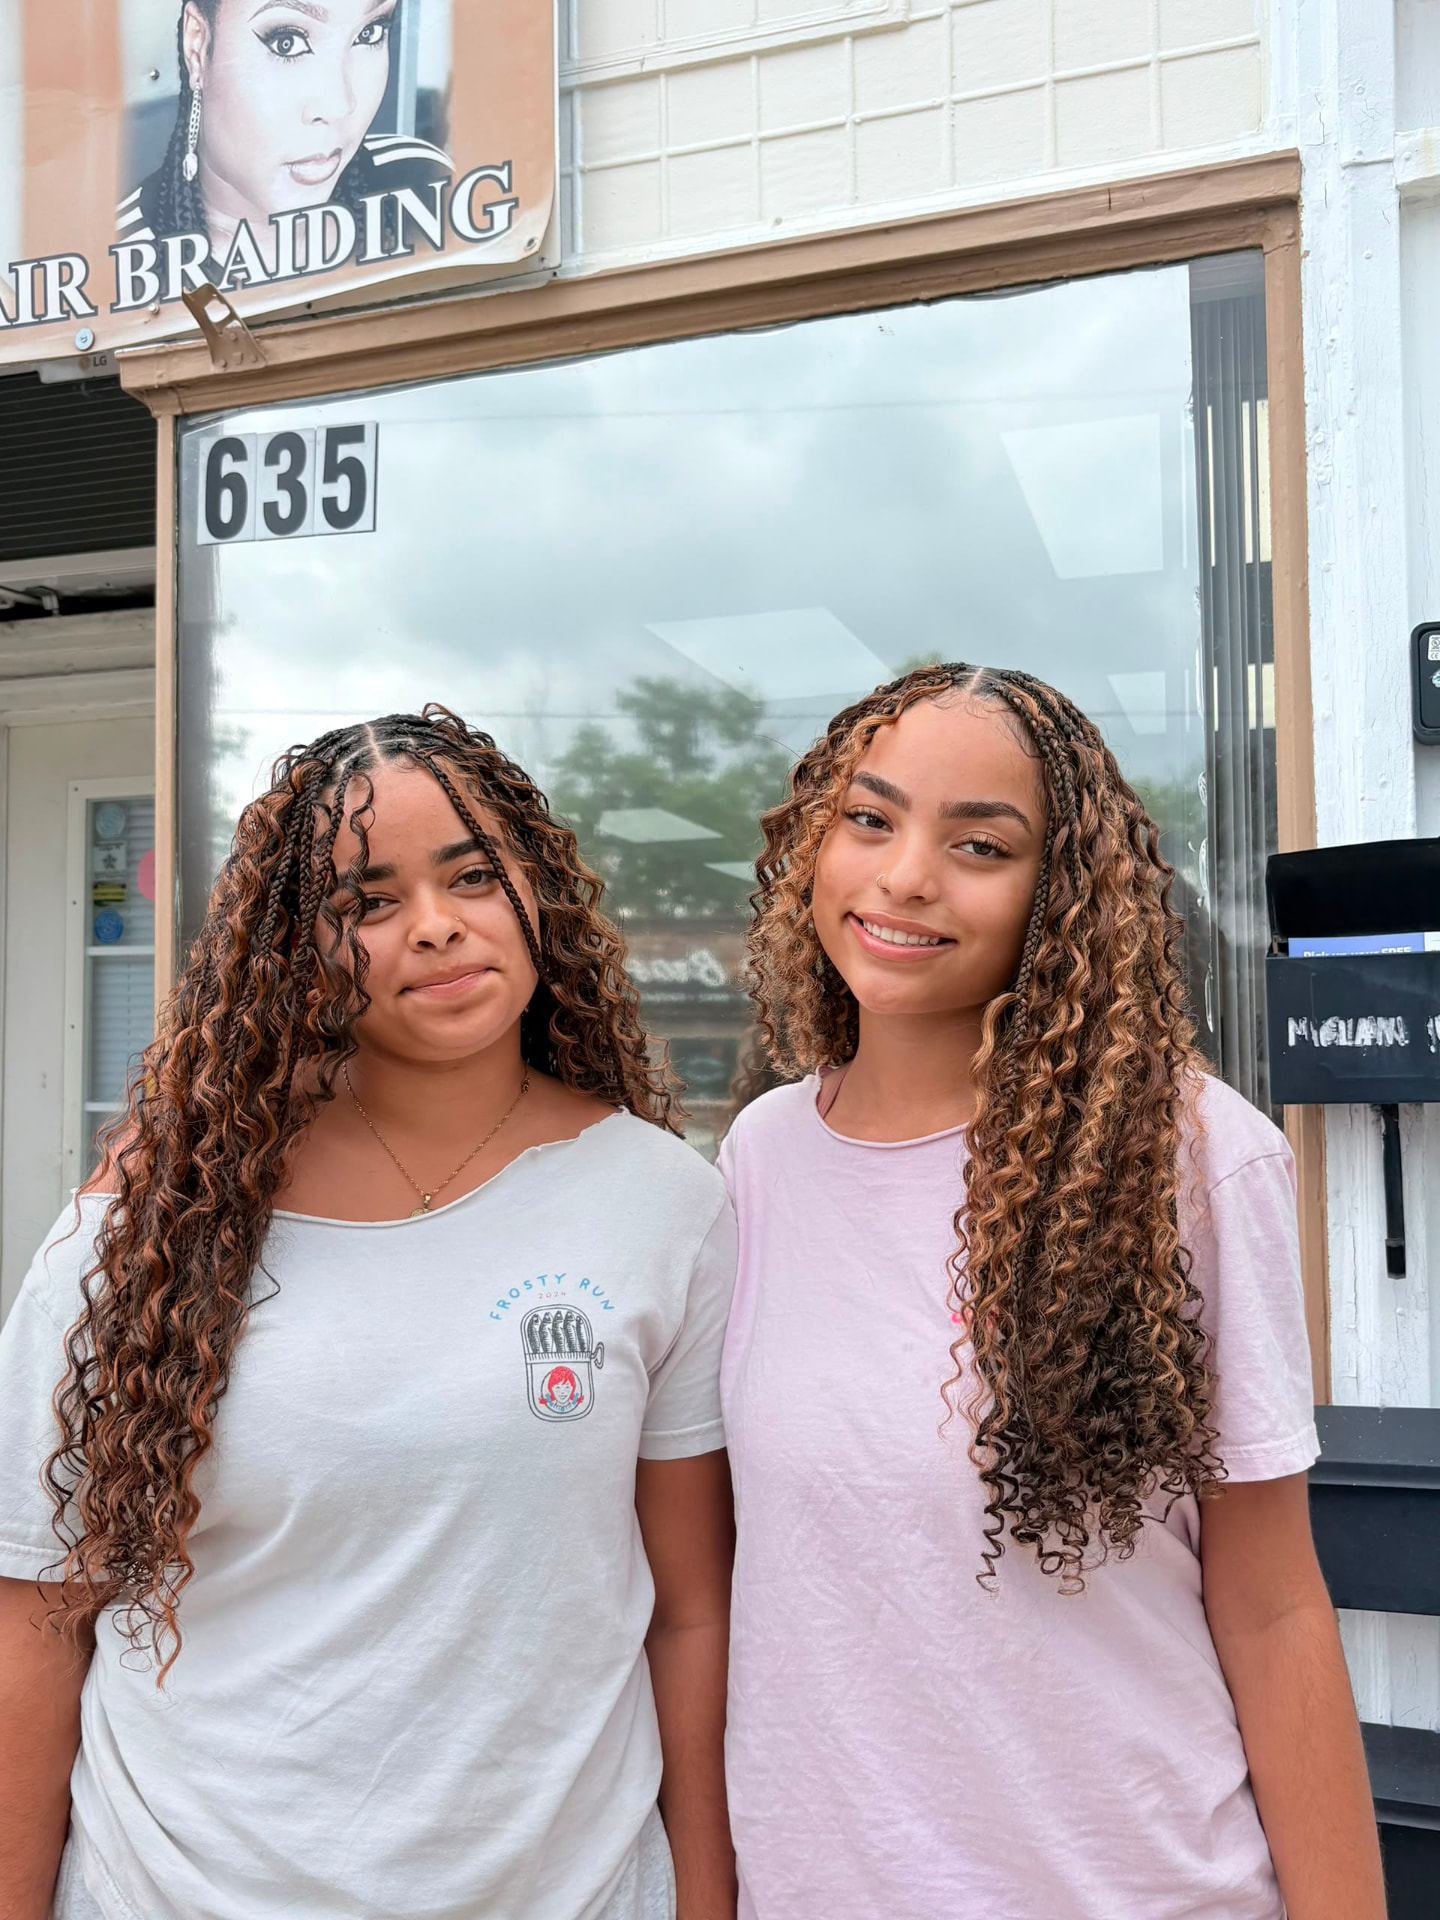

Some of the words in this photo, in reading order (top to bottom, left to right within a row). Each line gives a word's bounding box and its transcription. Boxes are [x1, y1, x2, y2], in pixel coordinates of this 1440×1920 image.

[0, 252, 98, 331] IR
[108, 160, 519, 313] BRAIDING
[92, 355, 107, 367] LG
[205, 424, 367, 540] 635
[490, 1273, 567, 1320] FROSTY
[579, 1278, 615, 1311] RUN
